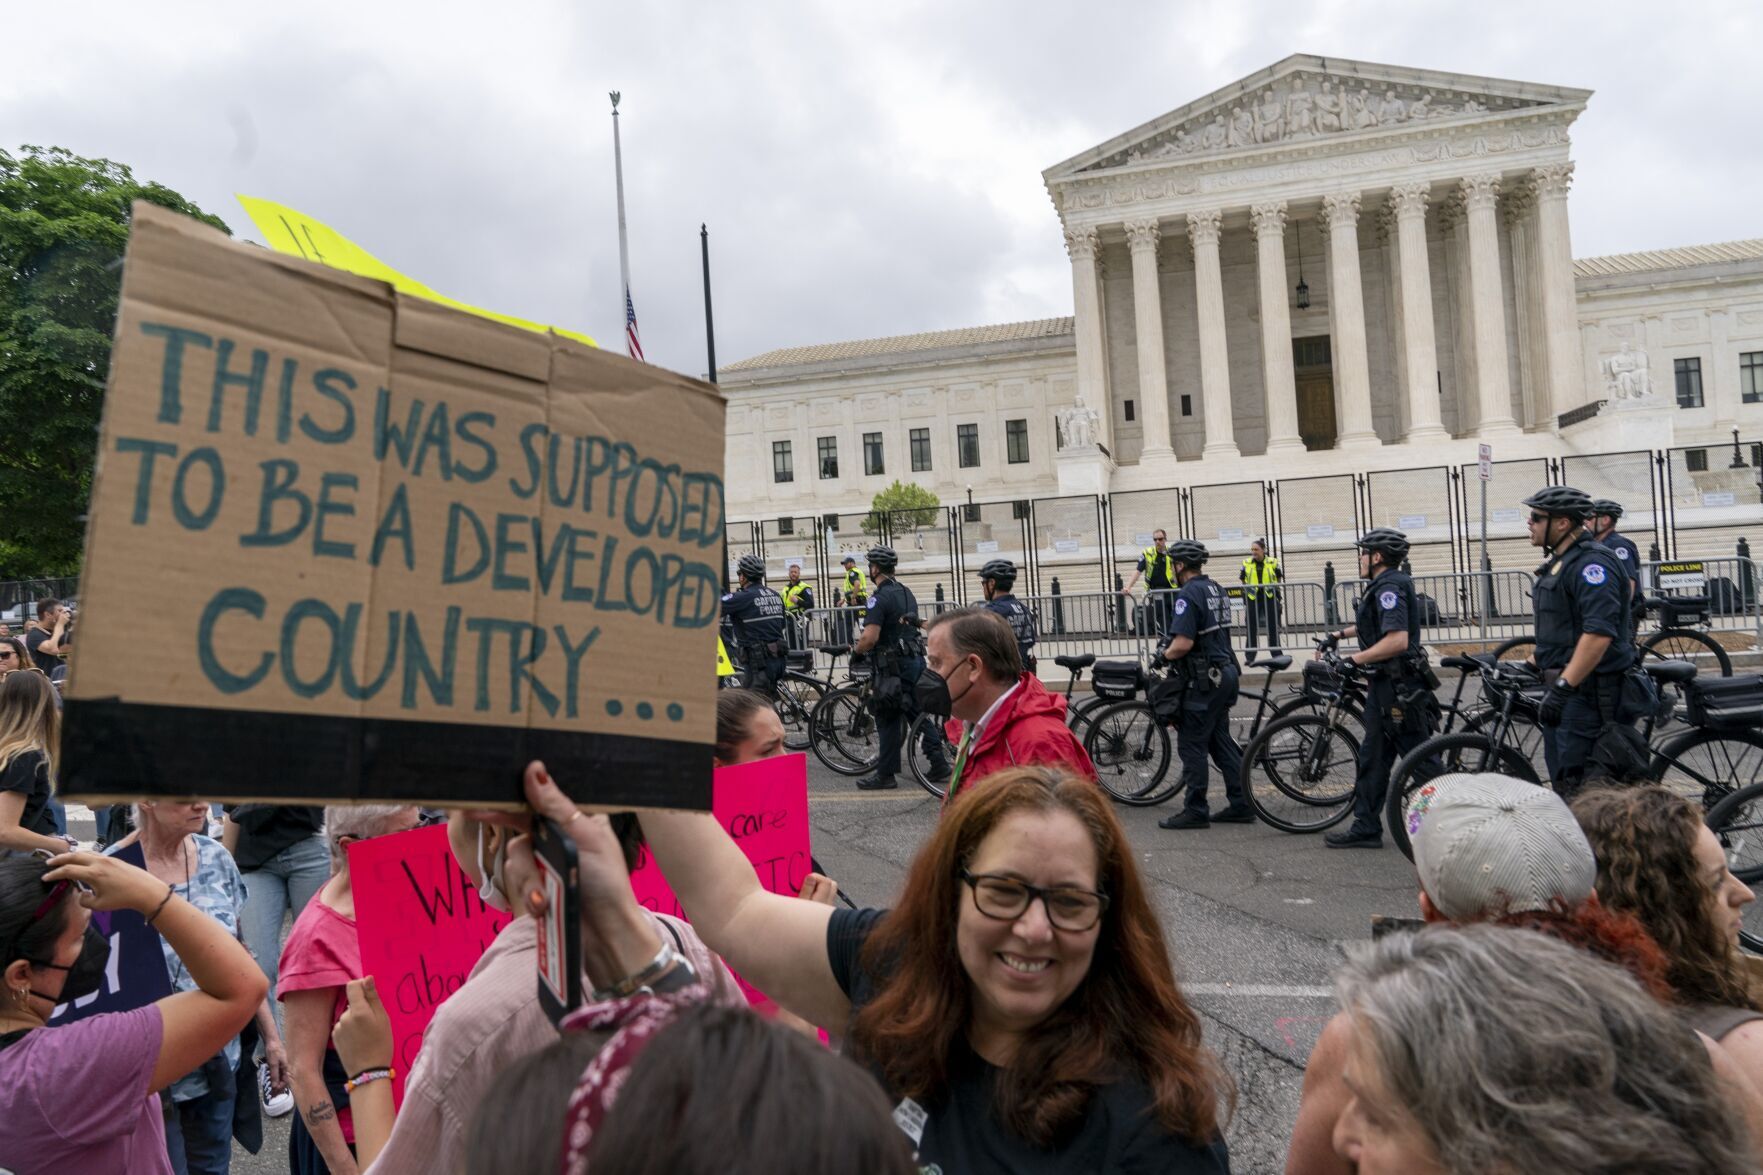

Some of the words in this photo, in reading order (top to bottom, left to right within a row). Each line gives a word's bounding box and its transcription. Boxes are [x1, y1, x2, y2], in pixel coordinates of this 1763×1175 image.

[1259, 165, 1313, 183] JUSTICE
[1319, 157, 1369, 173] UNDER
[1371, 153, 1398, 167] LAW
[139, 321, 359, 444] THIS
[373, 386, 499, 483] WAS
[509, 423, 725, 547] SUPPOSED
[115, 436, 226, 531] TO
[239, 458, 359, 560] BE
[367, 482, 415, 571] A
[442, 501, 721, 629] DEVELOPED
[1105, 689, 1125, 697] POLICE
[730, 808, 788, 839] care
